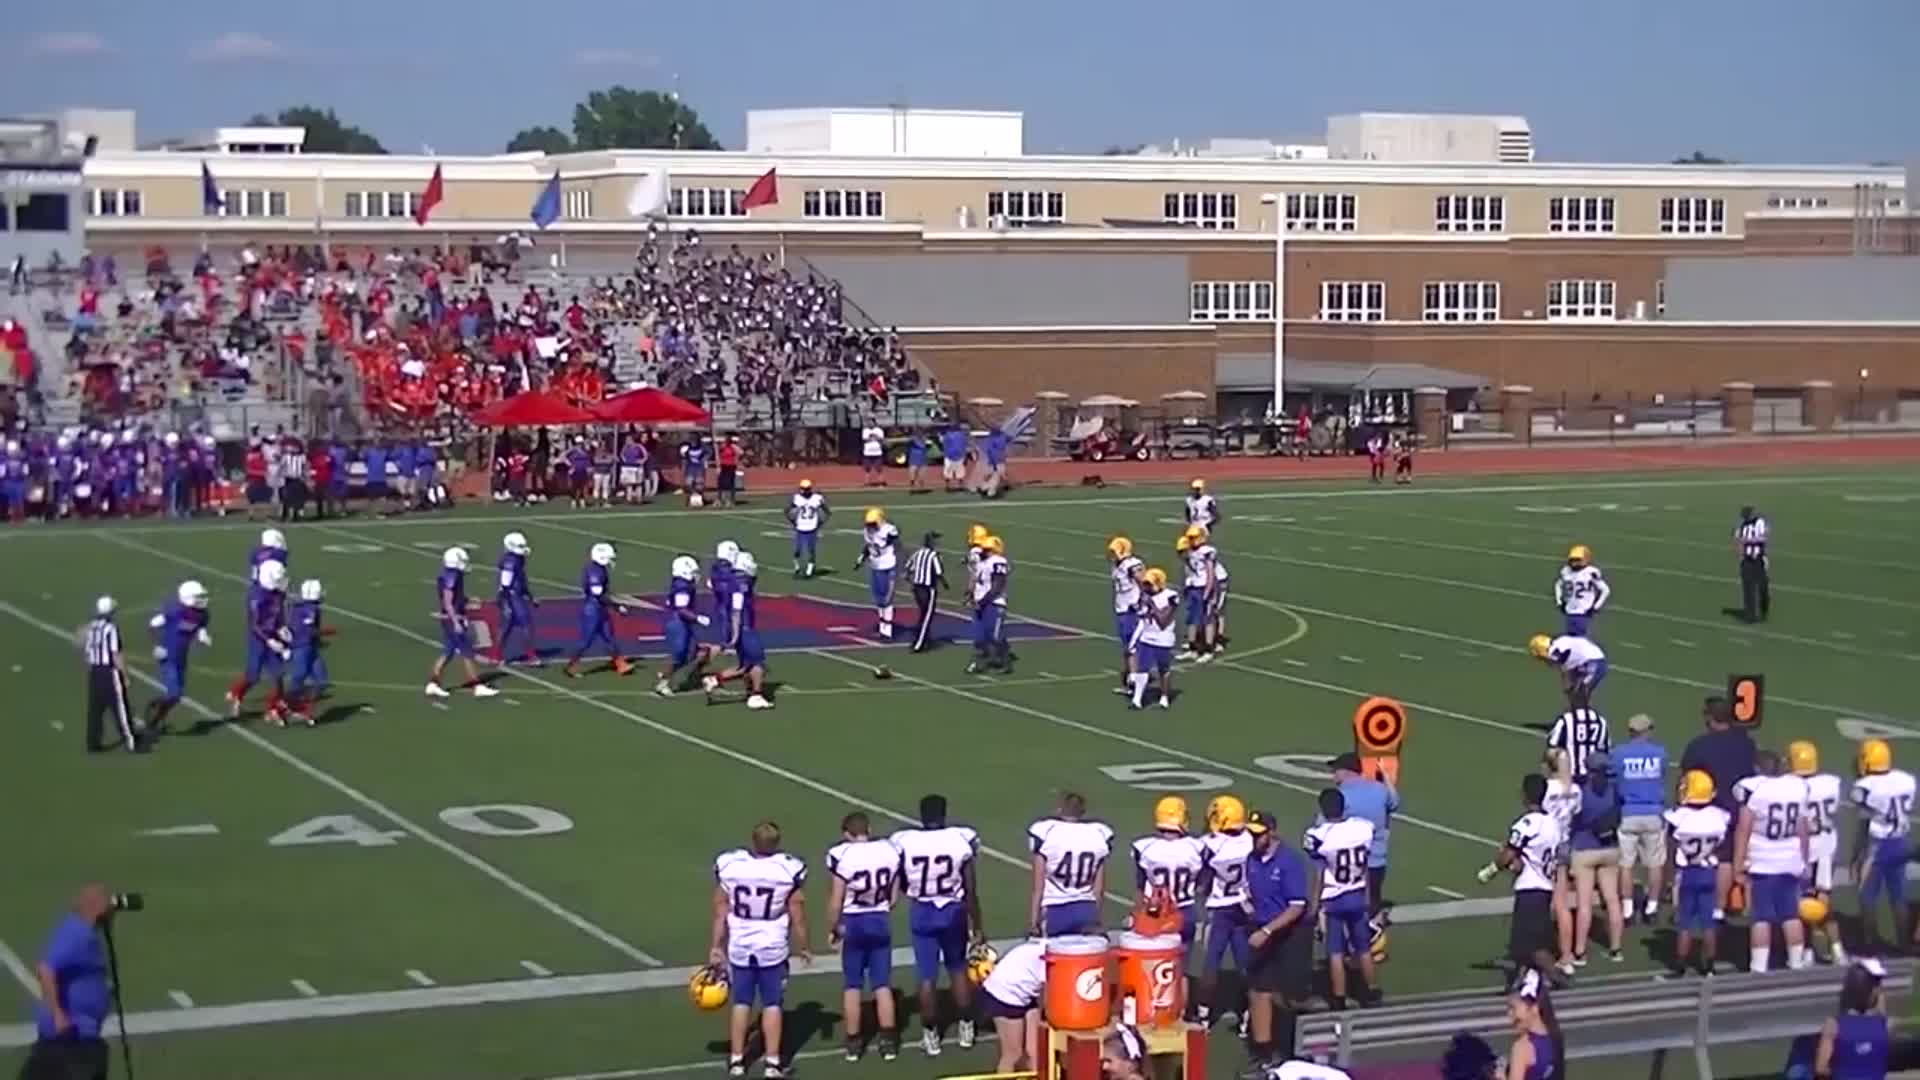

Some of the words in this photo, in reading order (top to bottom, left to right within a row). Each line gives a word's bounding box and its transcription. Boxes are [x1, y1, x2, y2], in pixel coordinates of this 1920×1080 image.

[1735, 680, 1756, 721] 3
[1576, 723, 1600, 742] 87
[1766, 802, 1799, 840] 68
[912, 854, 953, 896] 72
[1055, 850, 1096, 888] 40
[1335, 845, 1368, 884] 89
[733, 885, 775, 919] 67
[852, 867, 891, 906] 28
